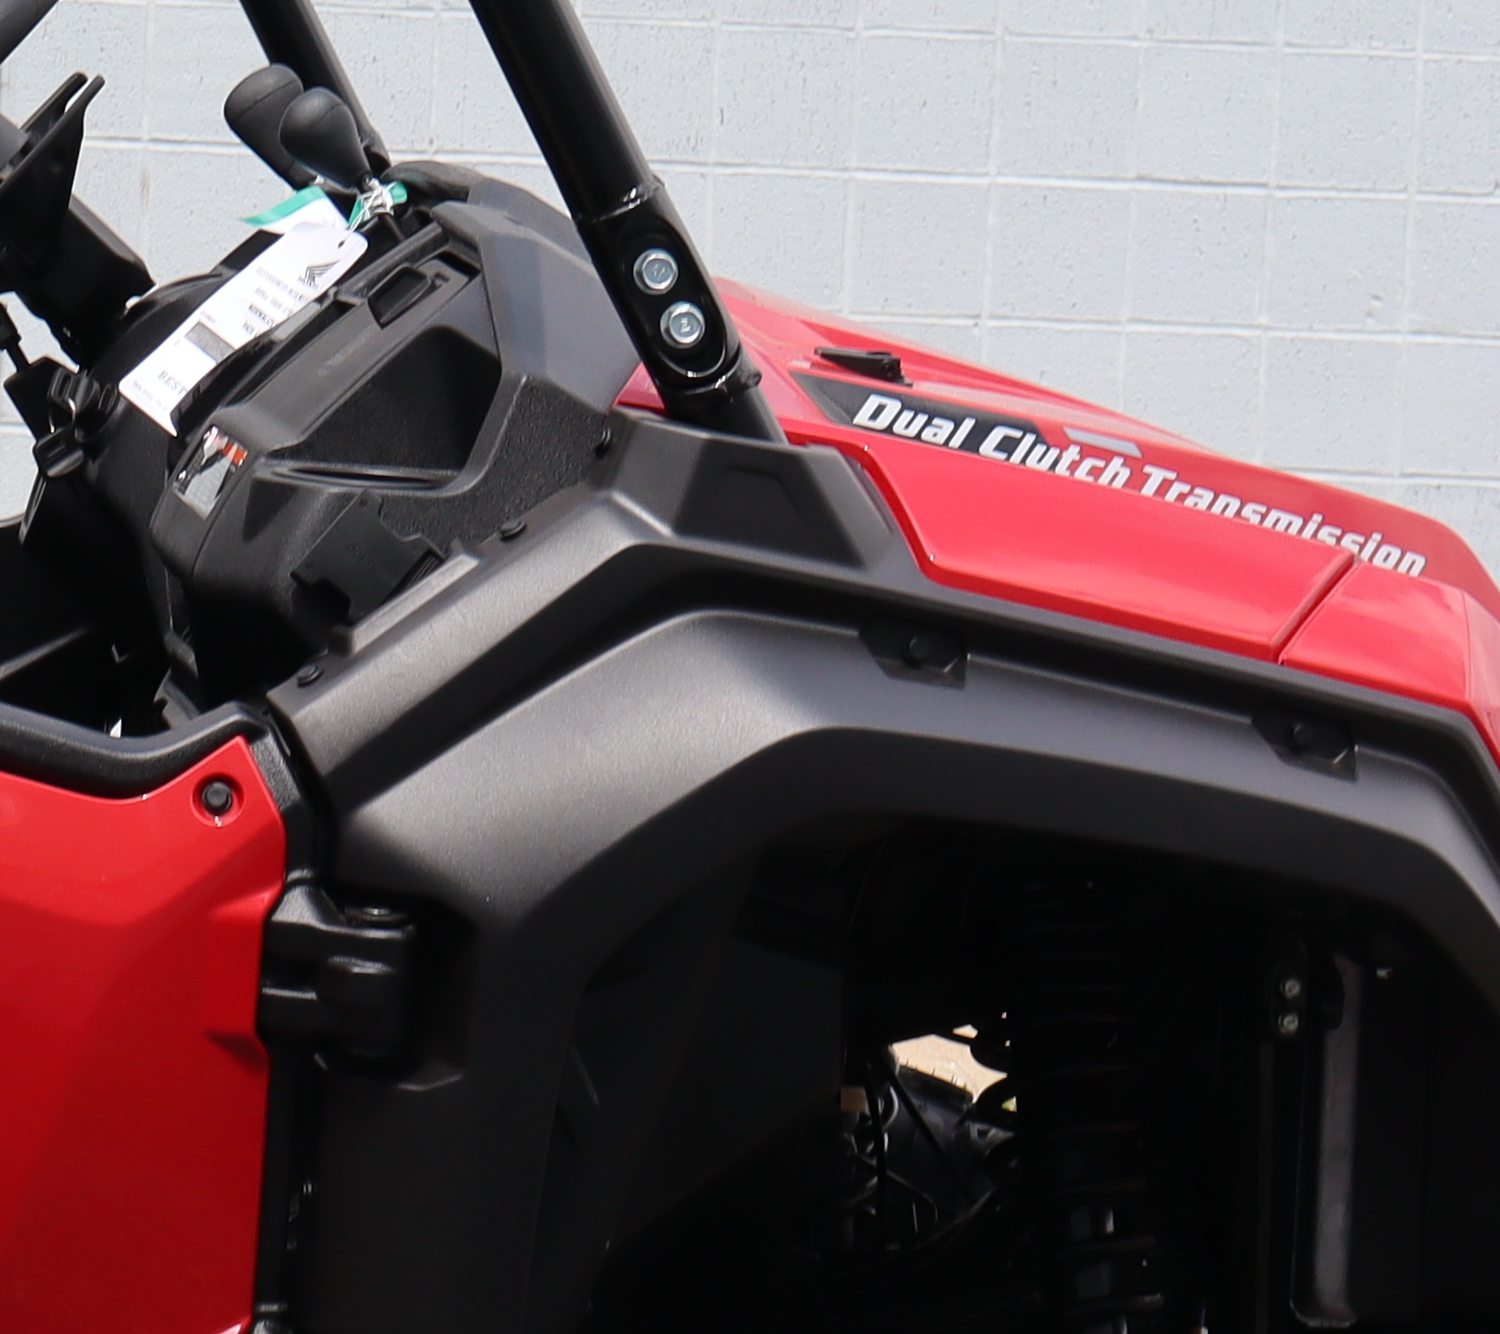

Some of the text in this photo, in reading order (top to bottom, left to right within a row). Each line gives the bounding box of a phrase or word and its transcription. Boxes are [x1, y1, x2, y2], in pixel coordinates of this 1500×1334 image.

[852, 393, 1427, 577] Dual Clutch Transmission
